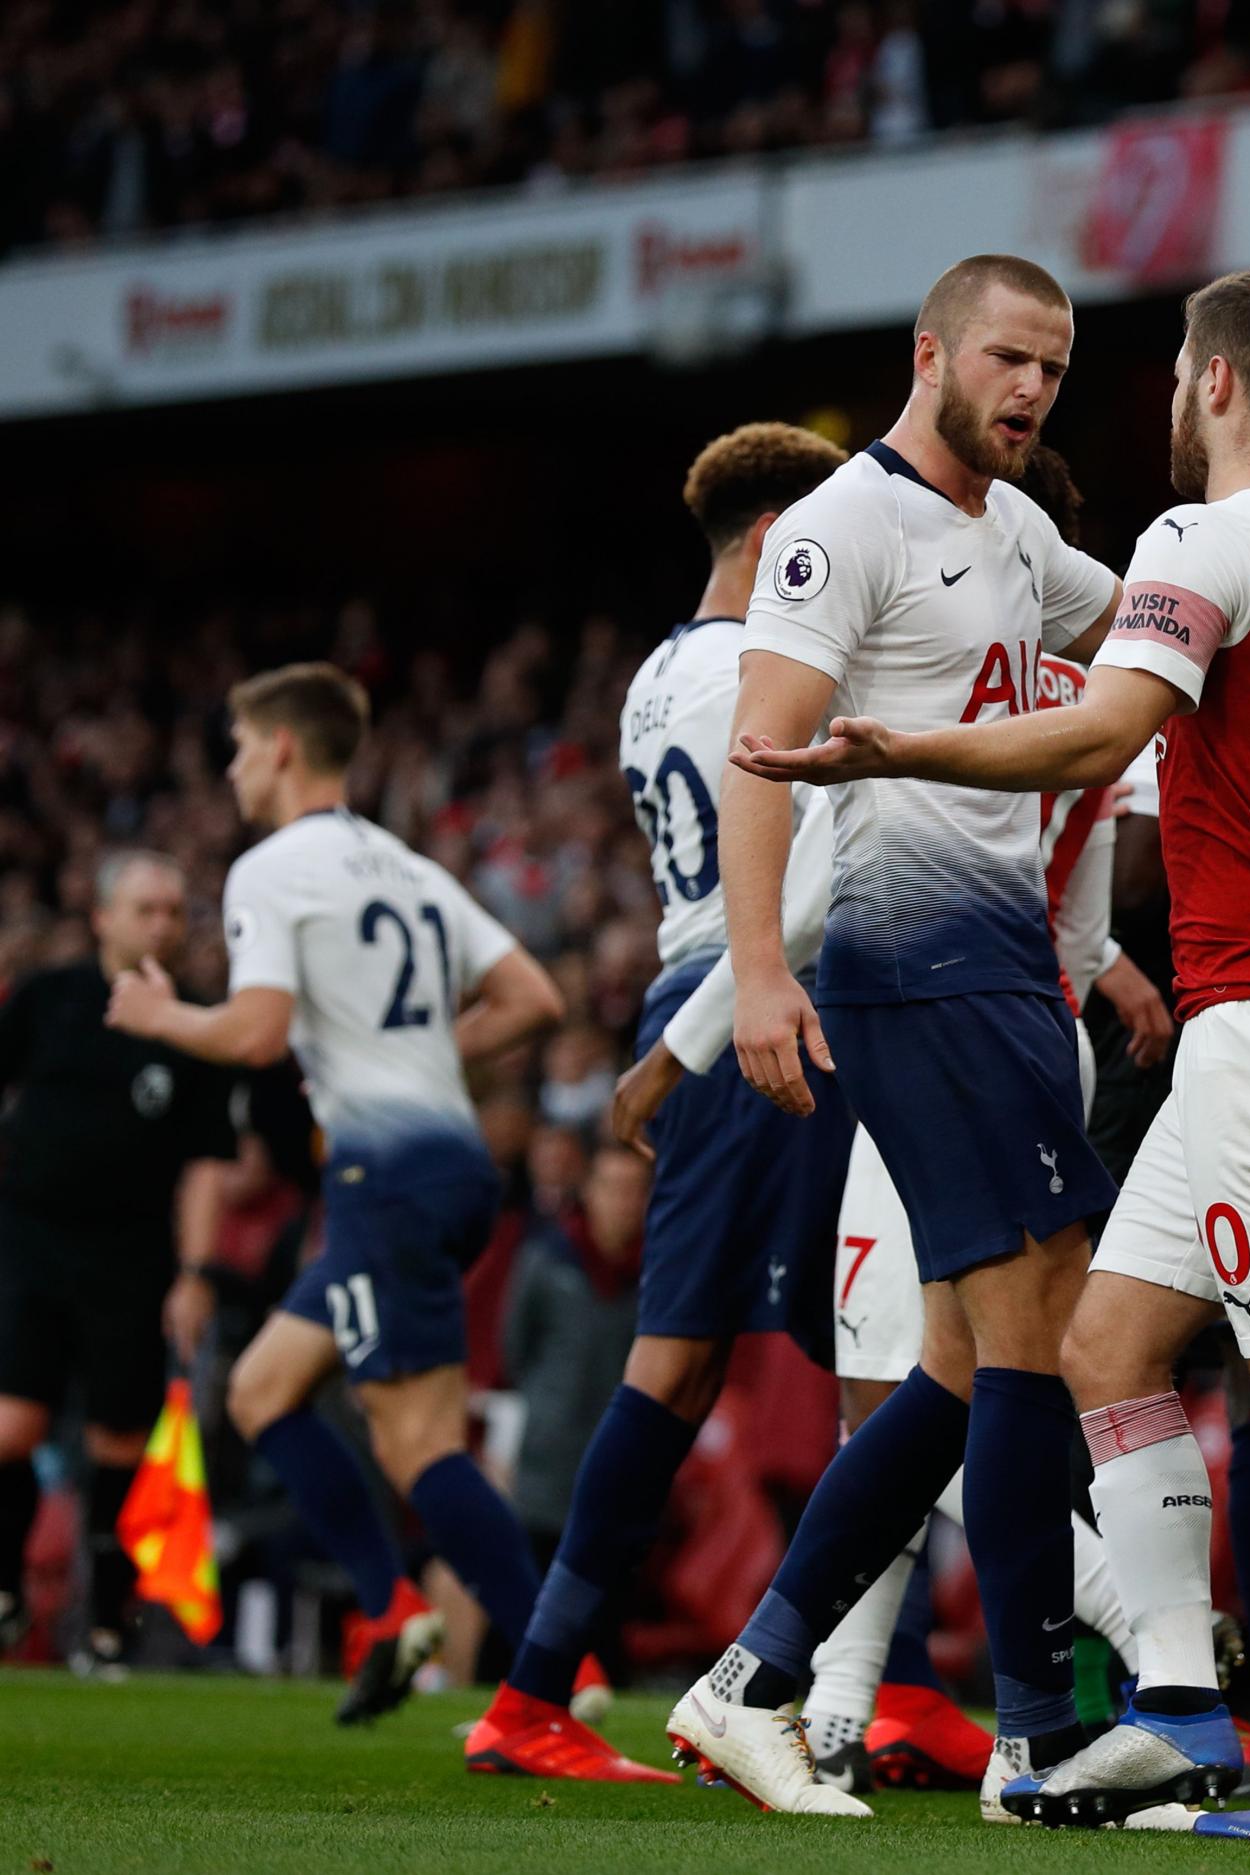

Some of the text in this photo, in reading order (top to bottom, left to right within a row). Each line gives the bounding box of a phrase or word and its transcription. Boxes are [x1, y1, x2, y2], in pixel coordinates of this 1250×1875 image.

[1131, 593, 1180, 615] VISIT
[360, 899, 453, 1031] 21
[326, 1272, 381, 1350] 21
